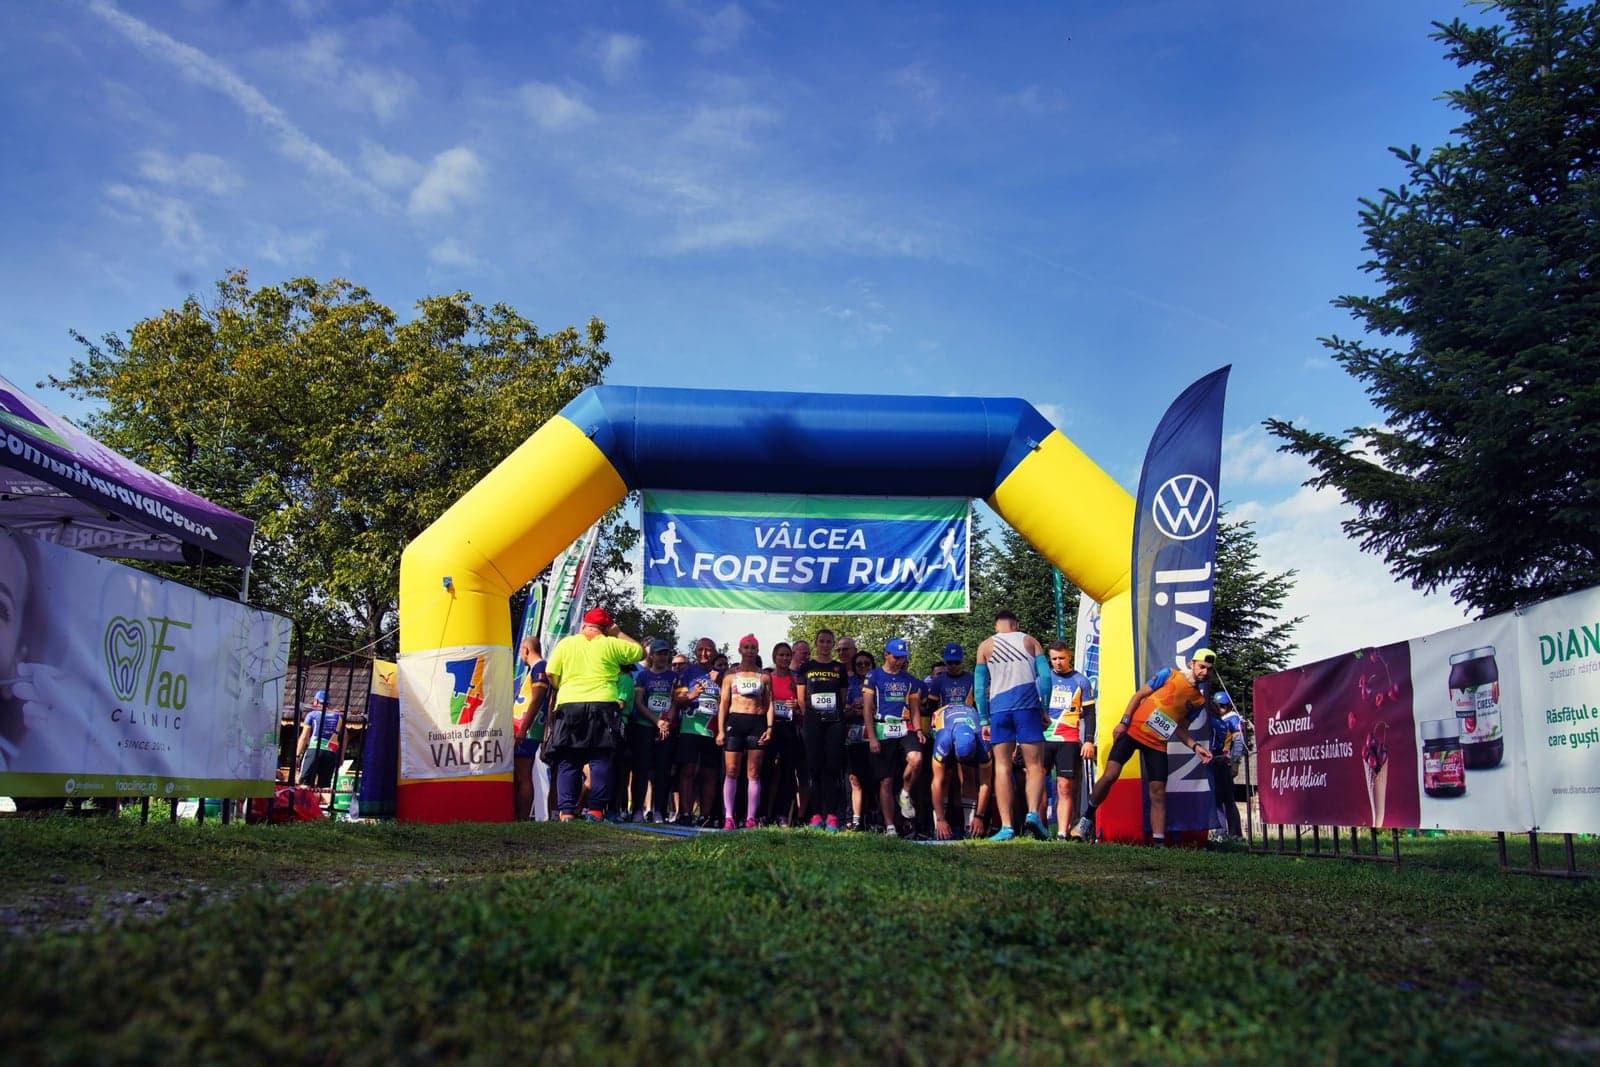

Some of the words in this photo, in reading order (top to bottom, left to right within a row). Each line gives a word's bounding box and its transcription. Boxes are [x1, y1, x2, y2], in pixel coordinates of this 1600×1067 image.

[754, 521, 866, 550] VÂLCEA
[691, 553, 839, 584] FOREST
[848, 557, 927, 585] RUN
[111, 708, 181, 730] CLINIC
[1153, 716, 1171, 731] 988
[124, 739, 149, 750] SINCE
[1548, 734, 1567, 747] care
[1300, 745, 1320, 761] DULCE
